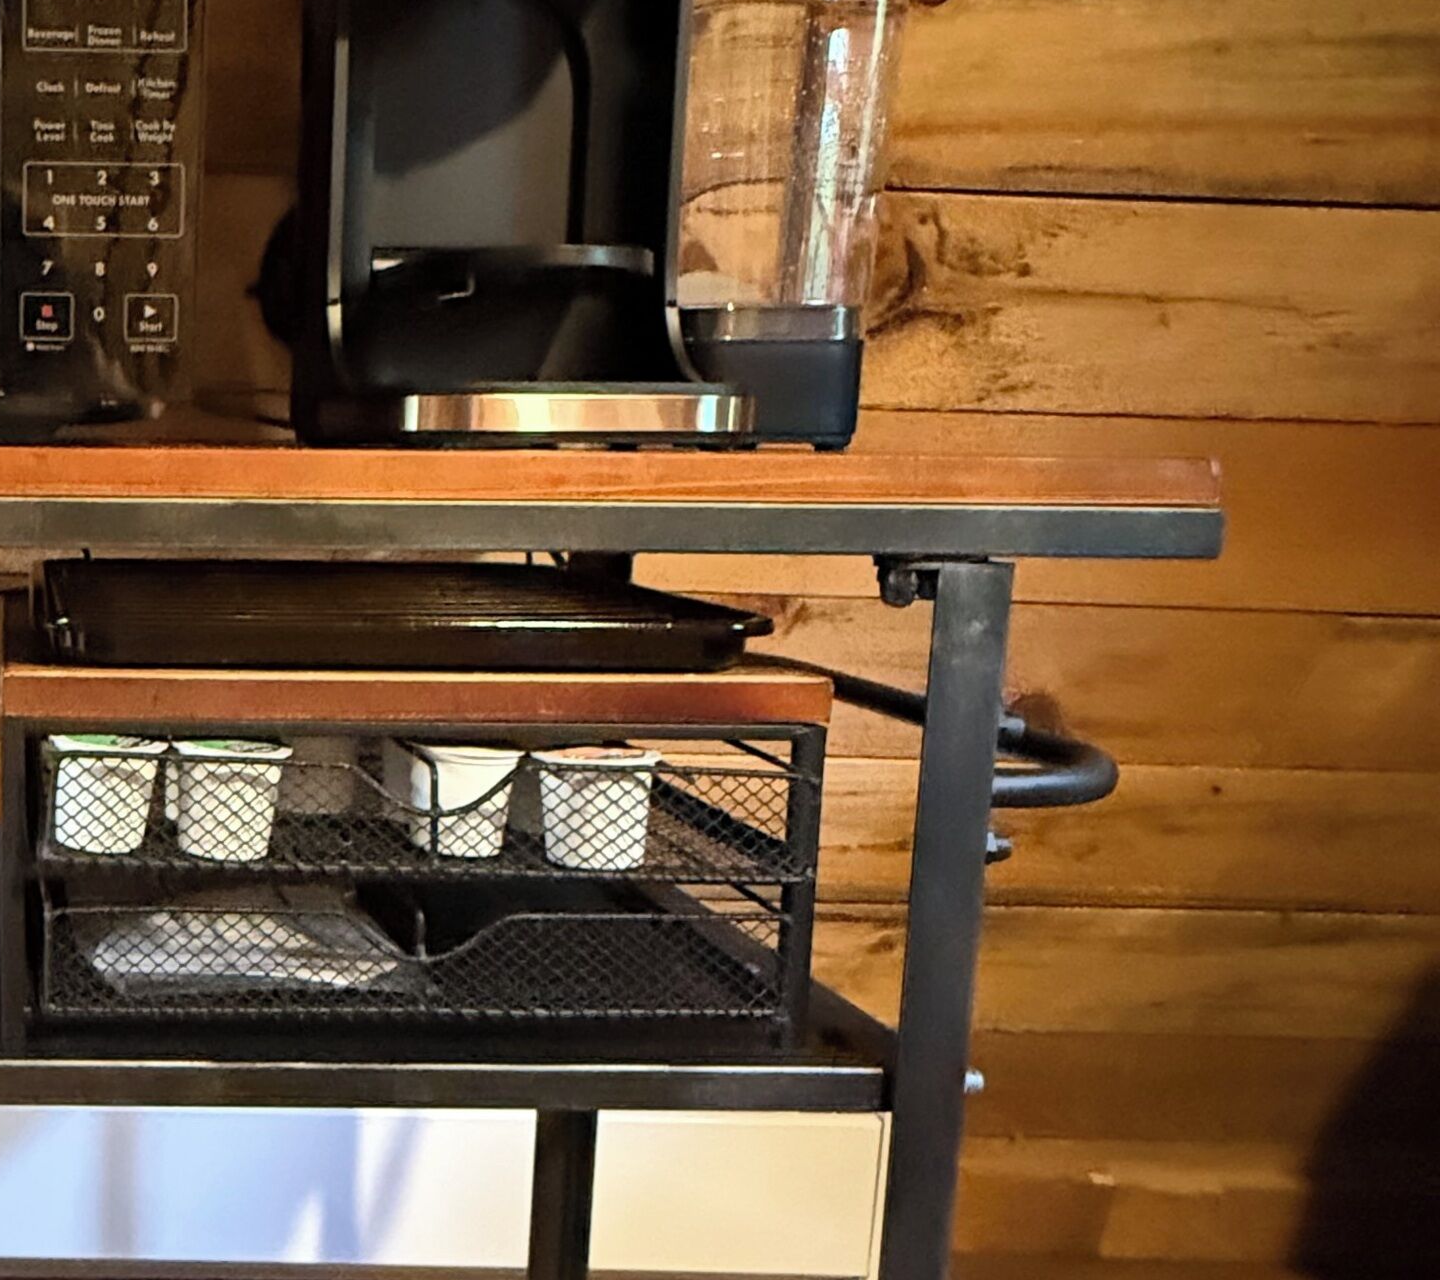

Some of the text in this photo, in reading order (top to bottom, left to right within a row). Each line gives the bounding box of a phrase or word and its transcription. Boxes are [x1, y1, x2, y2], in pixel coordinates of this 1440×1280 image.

[88, 24, 122, 35] Frozen
[34, 120, 65, 131] Power
[36, 131, 64, 142] Level
[46, 169, 54, 185] 1
[97, 170, 107, 186] 2
[150, 171, 160, 186] 3
[52, 194, 151, 207] ONE TOUCH START
[42, 215, 55, 231] 4
[95, 216, 106, 231] 5
[147, 217, 159, 232] 6
[41, 260, 54, 276] 7
[94, 261, 105, 276] 8
[146, 262, 158, 278] 9
[93, 307, 105, 322] 0
[35, 320, 59, 332] Stop
[139, 321, 163, 333] Start
